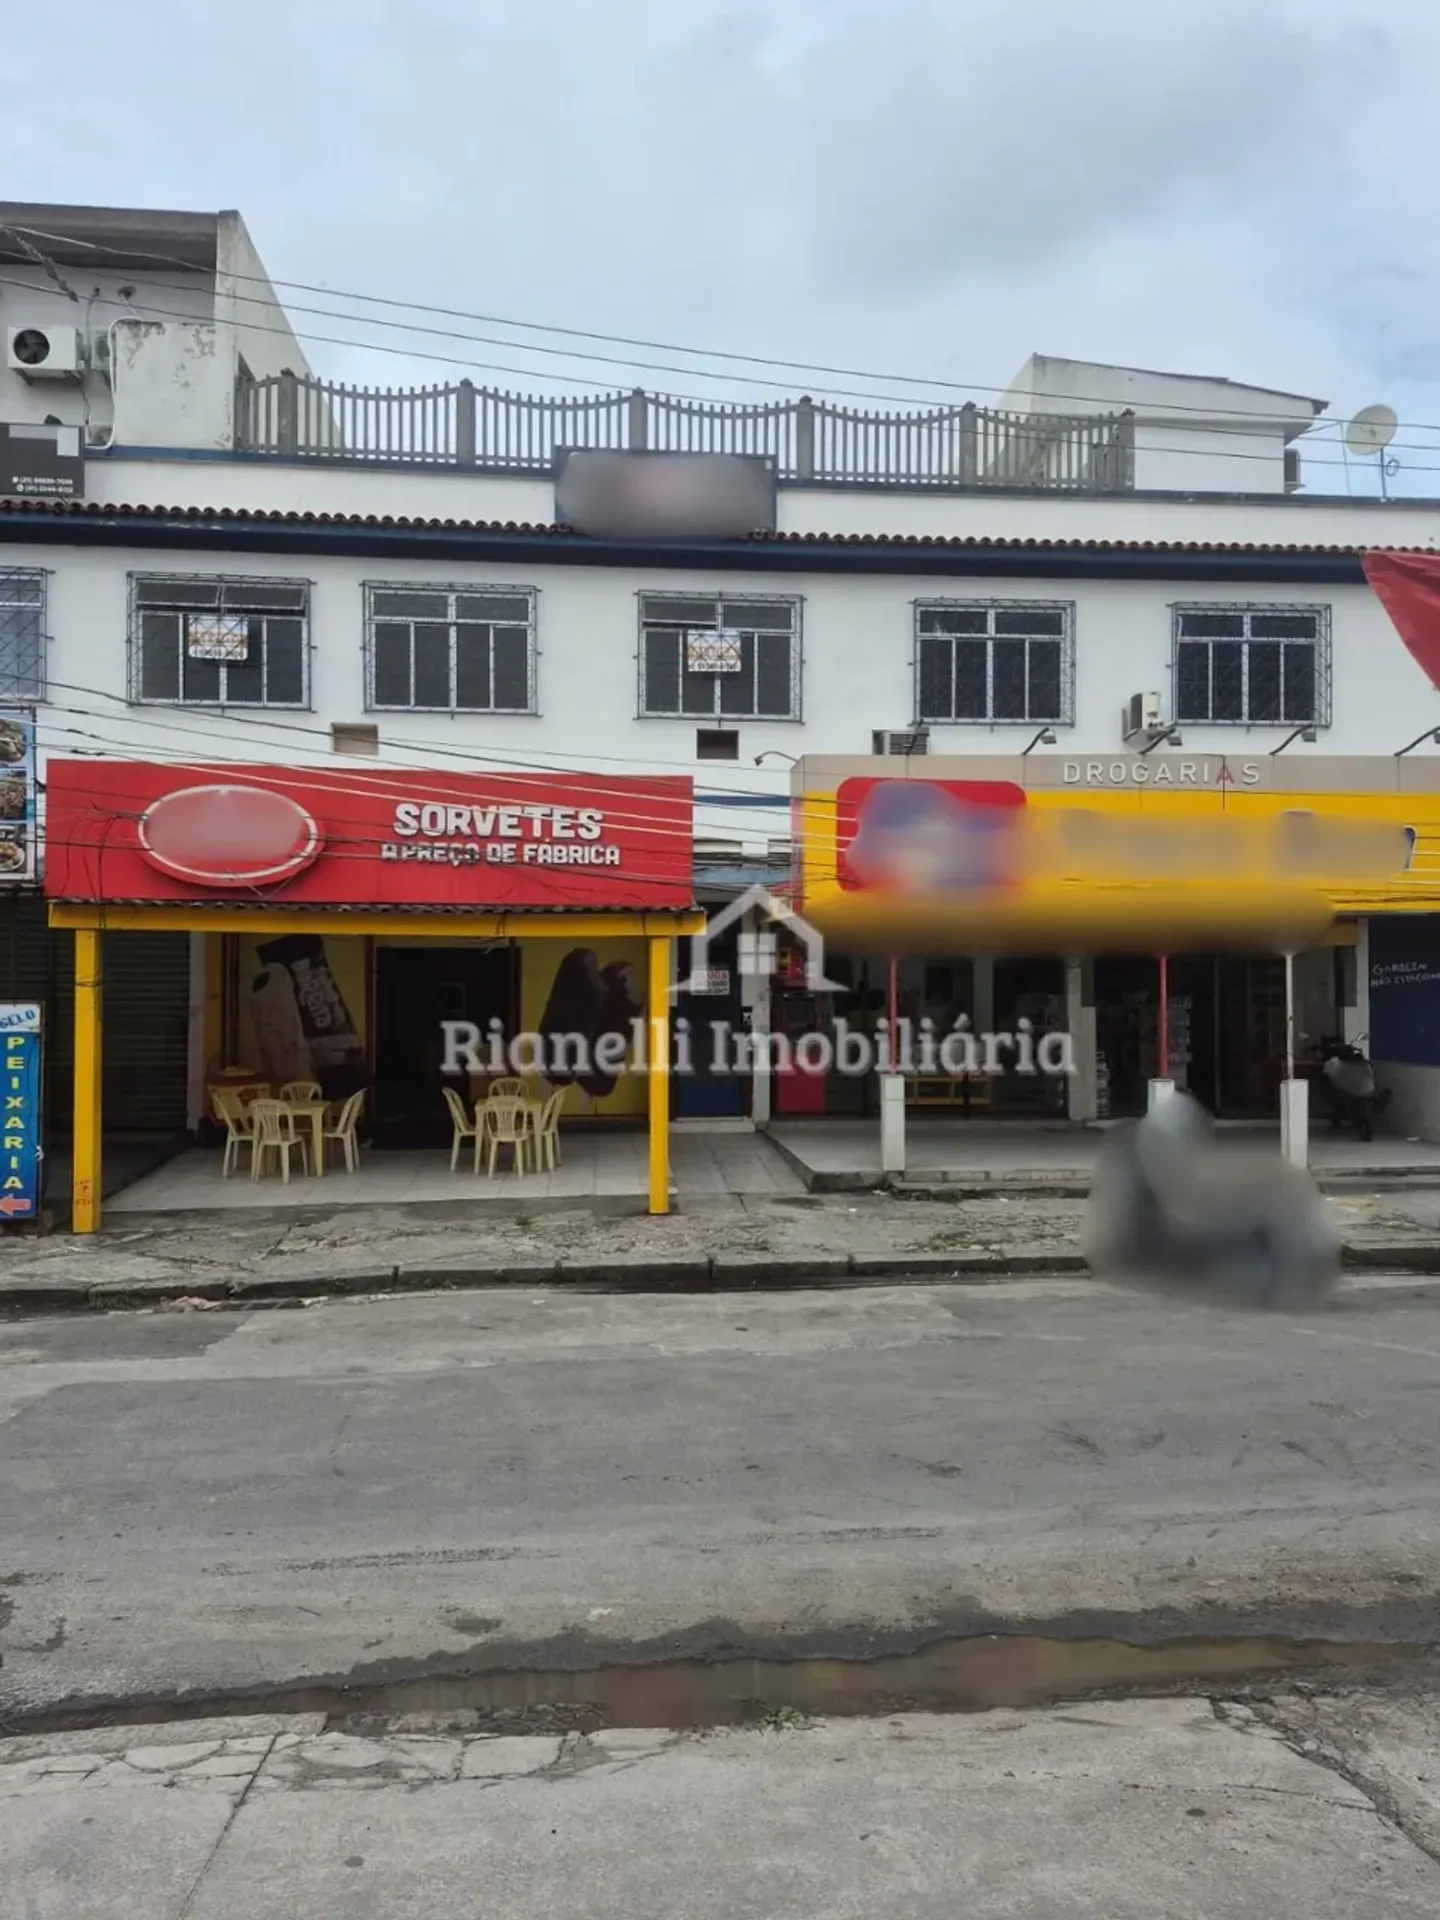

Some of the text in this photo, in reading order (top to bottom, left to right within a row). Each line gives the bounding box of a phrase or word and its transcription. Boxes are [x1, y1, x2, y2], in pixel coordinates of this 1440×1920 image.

[1063, 762, 1261, 784] DROGARIAS
[393, 803, 603, 840] SORVETES
[486, 844, 515, 863] DE
[4, 1036, 25, 1190] PEIXARIA
